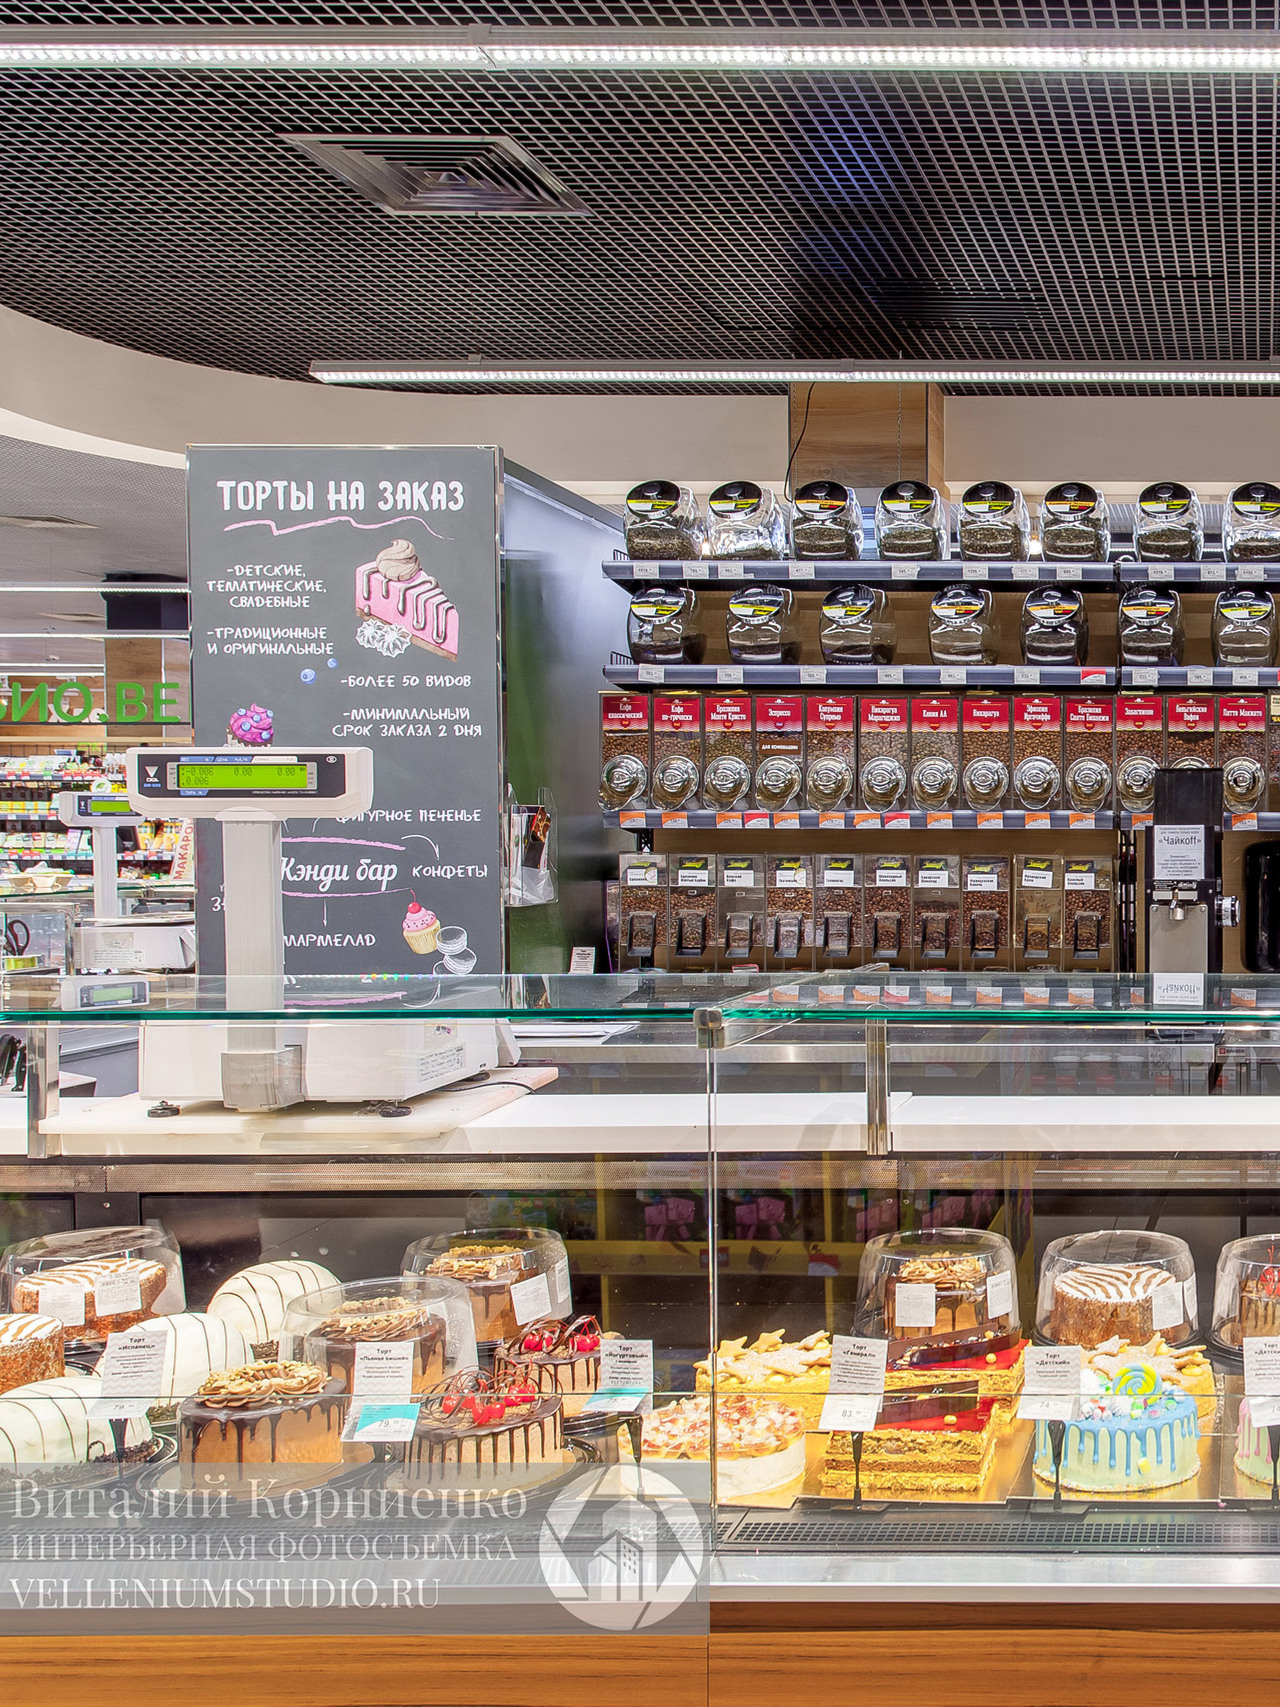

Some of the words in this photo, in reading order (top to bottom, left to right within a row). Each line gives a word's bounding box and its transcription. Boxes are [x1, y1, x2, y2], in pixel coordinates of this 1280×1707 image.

[216, 480, 314, 511] ТОРТЫ
[327, 480, 365, 511] НА
[377, 480, 465, 511] ЗАКАЗ
[206, 579, 327, 593] ТЕМАТИЧЕСКИЕ,
[229, 595, 310, 609] СВАДЕБНЫЕ
[207, 627, 327, 642] -ТРАДИЦИОННЫЕ
[207, 643, 218, 655] И
[223, 642, 334, 656] ОРИГИНАЛЬНЫЕ
[402, 675, 420, 687] 50
[426, 675, 472, 688] ВИДОВ
[0, 682, 181, 723] ИО.ВЕ
[331, 723, 371, 737] СРОК
[381, 723, 432, 737] ЗАКАЗА
[438, 724, 448, 737] 2
[453, 723, 482, 738] ДНЯ
[277, 766, 296, 776] 0.00
[419, 809, 482, 823] ПЕЧЕНЬЕ
[281, 857, 350, 892] Кэнди
[357, 857, 398, 892] бар
[412, 863, 489, 879] КОНФЕТЫ
